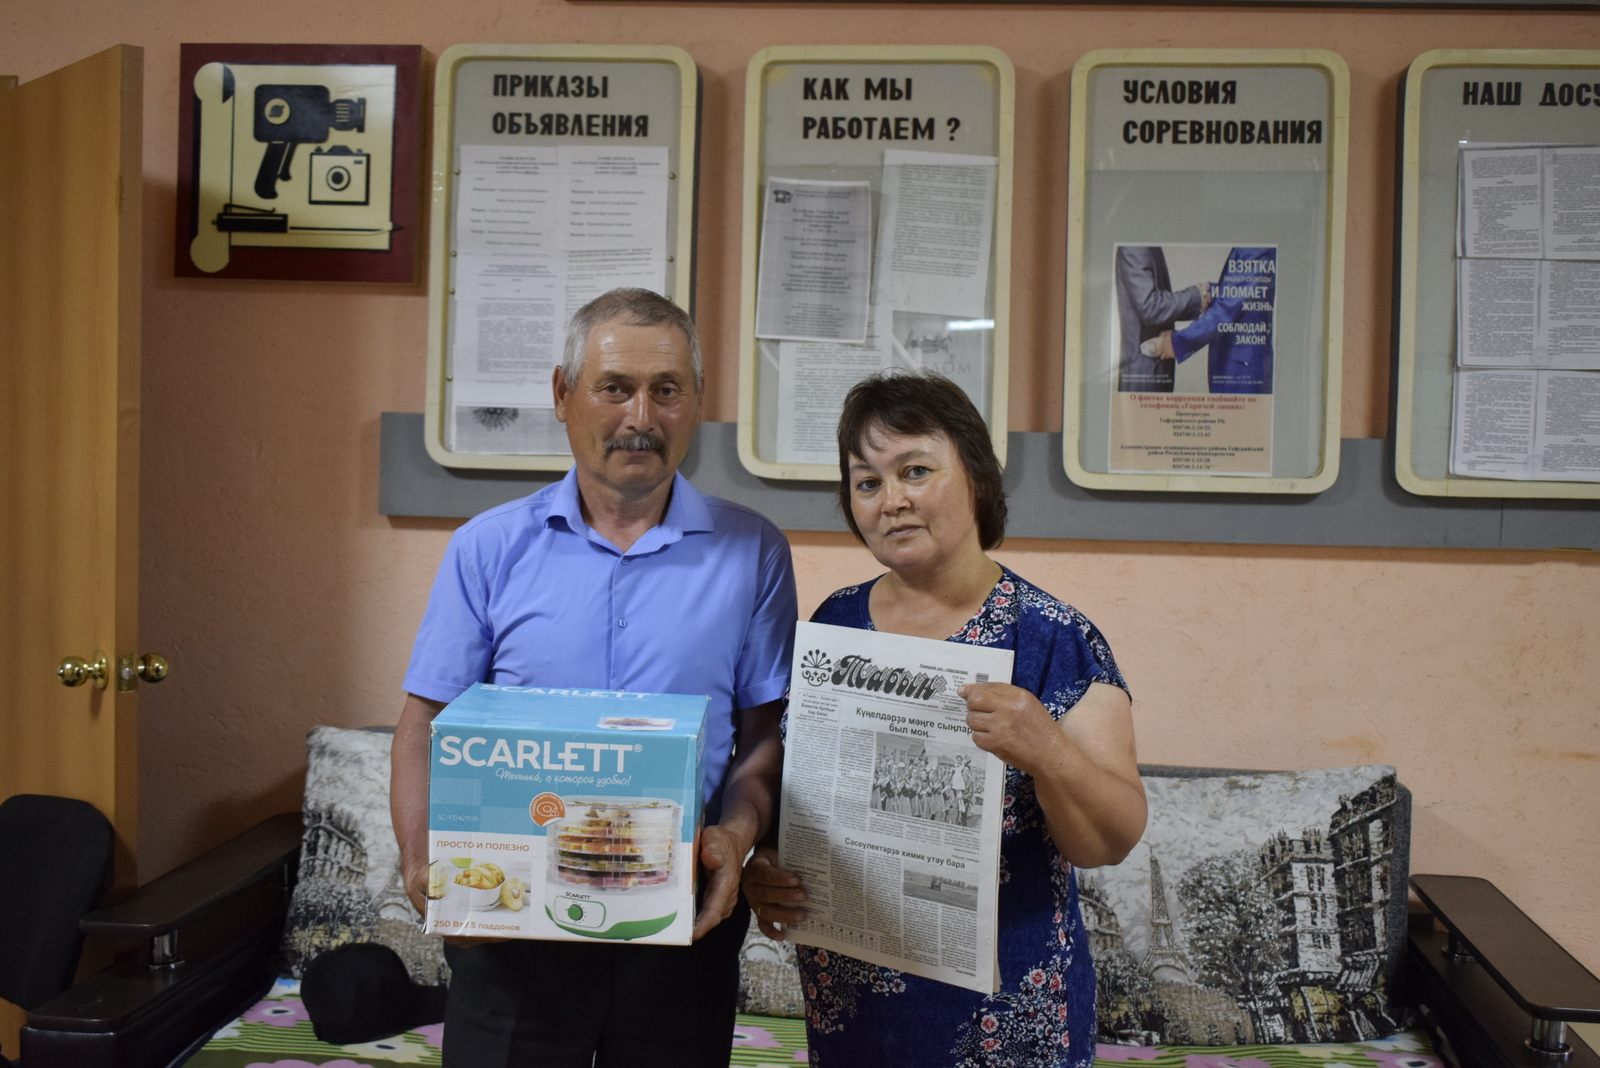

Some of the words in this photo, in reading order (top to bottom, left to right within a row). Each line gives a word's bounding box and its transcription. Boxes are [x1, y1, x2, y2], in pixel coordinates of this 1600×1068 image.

[493, 74, 608, 98] ПРИКАЗЫ
[803, 77, 850, 101] КАК
[864, 77, 912, 101] МЫ
[1123, 80, 1237, 105] УСЛОВИЯ
[1462, 81, 1522, 106] НАШ
[492, 112, 649, 137] ОБЪЯВЛЕНИЯ
[802, 116, 936, 141] РАБОТАЕМ
[946, 117, 961, 142] ?
[1122, 120, 1322, 145] СОРЕВНОВАНИЯ
[1228, 260, 1276, 273] ВЗЯТКА
[1211, 286, 1219, 298] И
[1221, 286, 1268, 299] ЛОМАЕТ
[1235, 335, 1266, 345] ЗАКОН!
[1138, 394, 1164, 402] фактах
[1166, 395, 1206, 404] коррупции
[1207, 395, 1246, 403] сообщайте
[1140, 402, 1180, 410] телефонам
[479, 684, 652, 699] SCARLETT
[889, 724, 908, 735] был
[438, 735, 634, 773] SCARLETT
[595, 774, 633, 788] удобно!
[436, 840, 475, 849] ПРОСТО
[485, 842, 530, 852] ПОЛЕЗНО
[901, 850, 926, 861] химик
[926, 854, 945, 866] утау
[946, 858, 966, 870] бара
[565, 891, 591, 900] SCARLETT
[433, 920, 451, 928] 250
[470, 921, 477, 929] 5
[478, 923, 521, 931] поддонов
